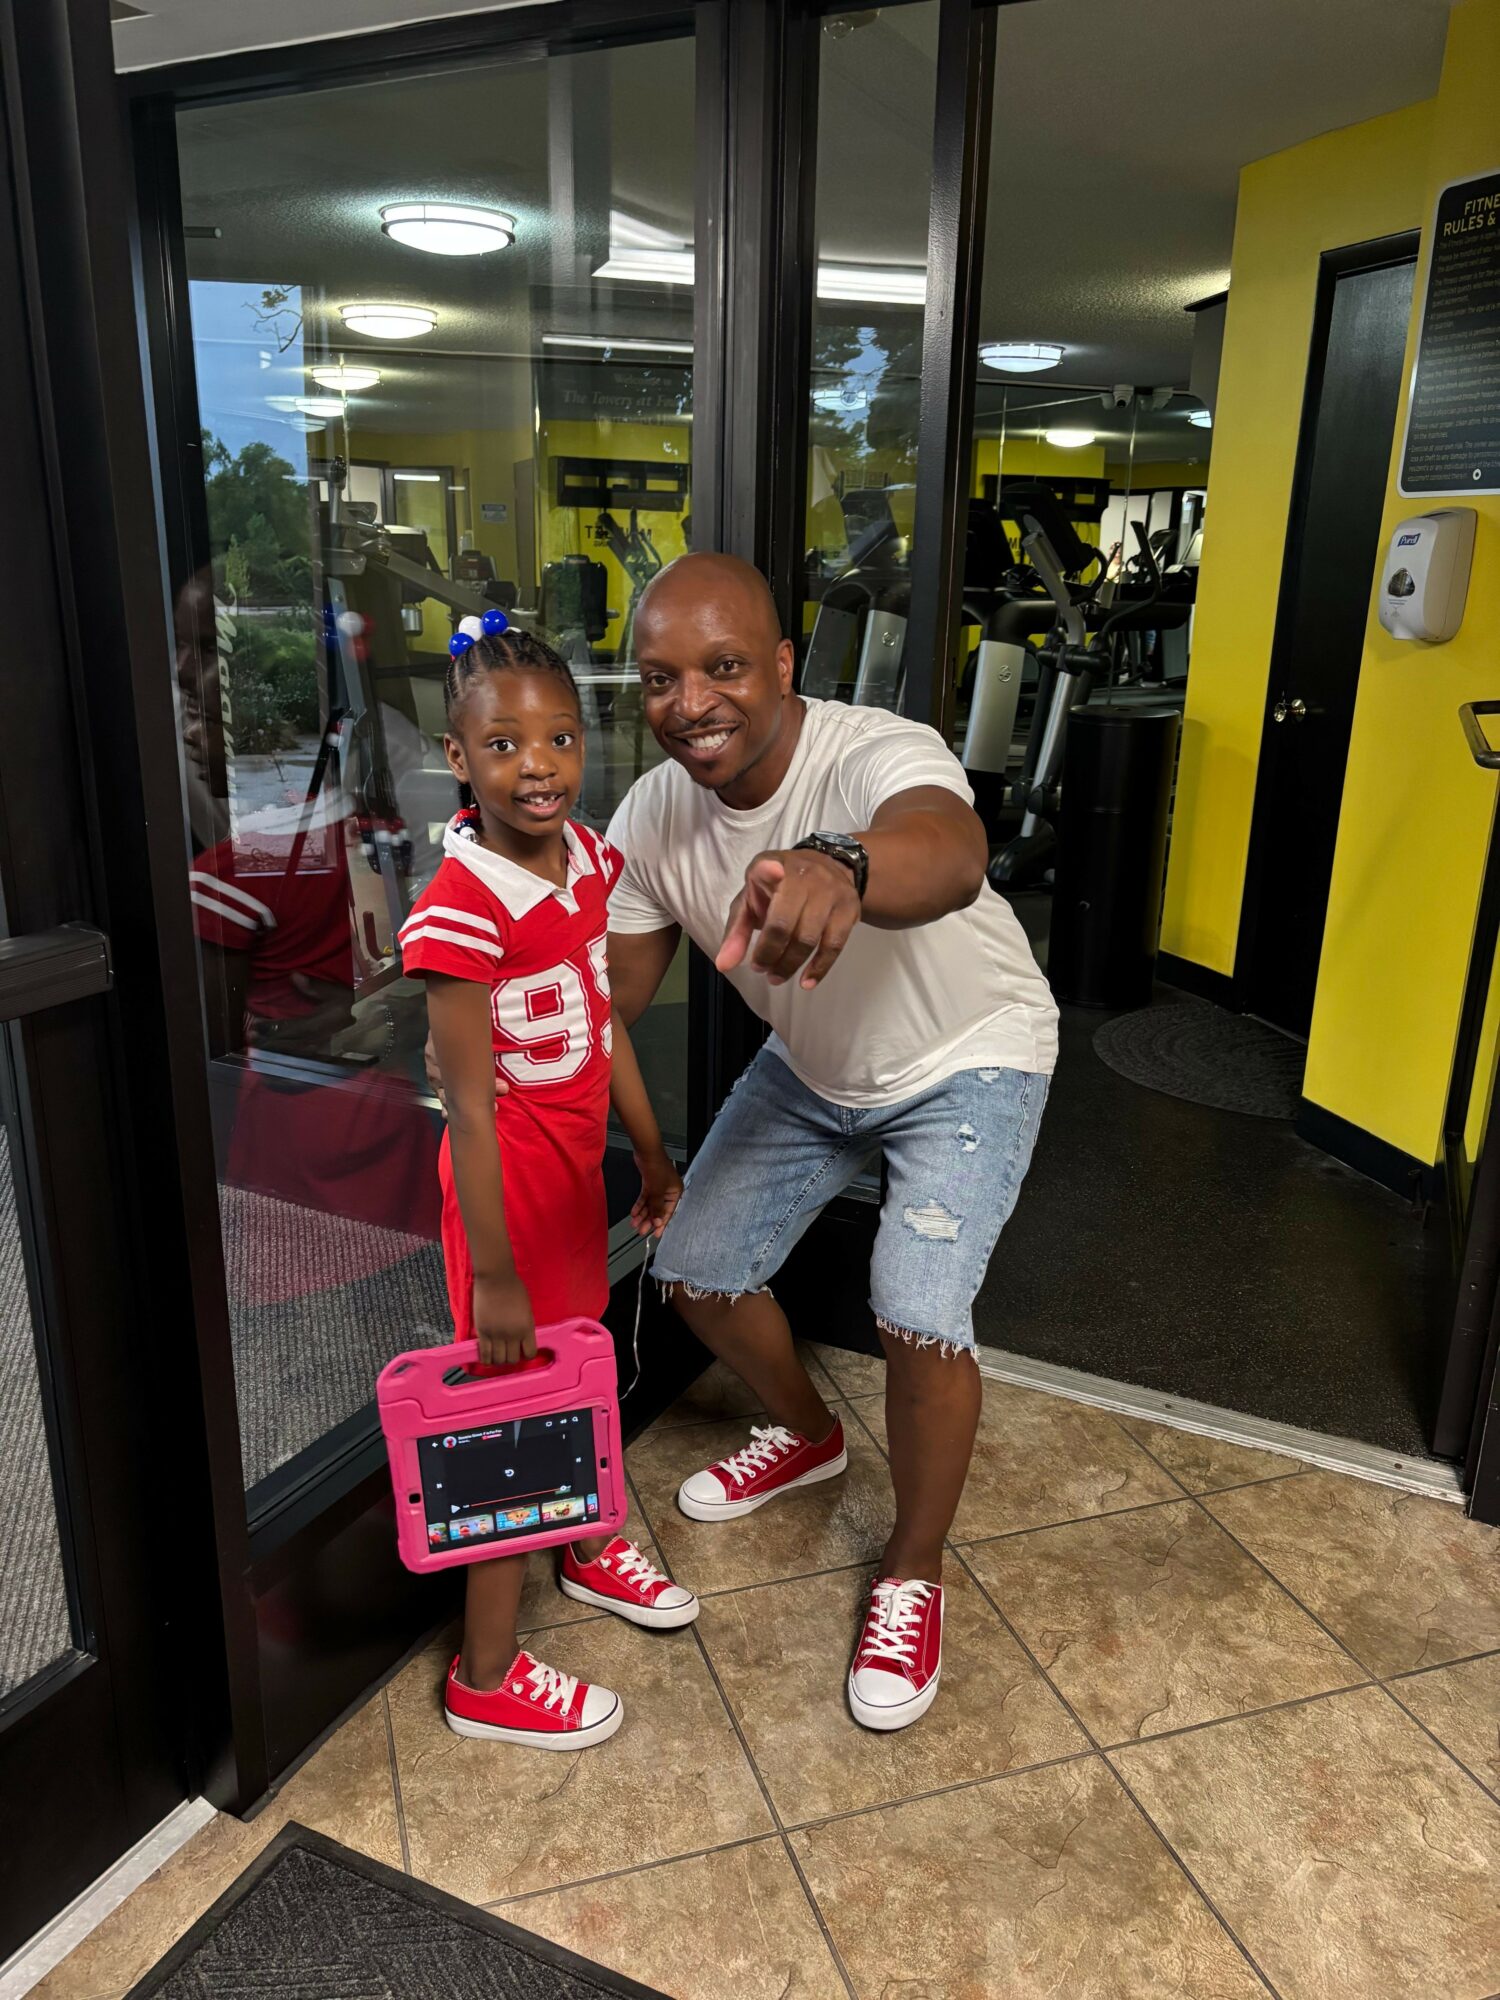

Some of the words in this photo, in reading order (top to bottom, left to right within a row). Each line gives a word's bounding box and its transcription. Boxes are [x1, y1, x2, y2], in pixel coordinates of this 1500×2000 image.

[1464, 194, 1500, 216] FITNE
[1443, 213, 1485, 237] RULES
[1487, 211, 1497, 226] &
